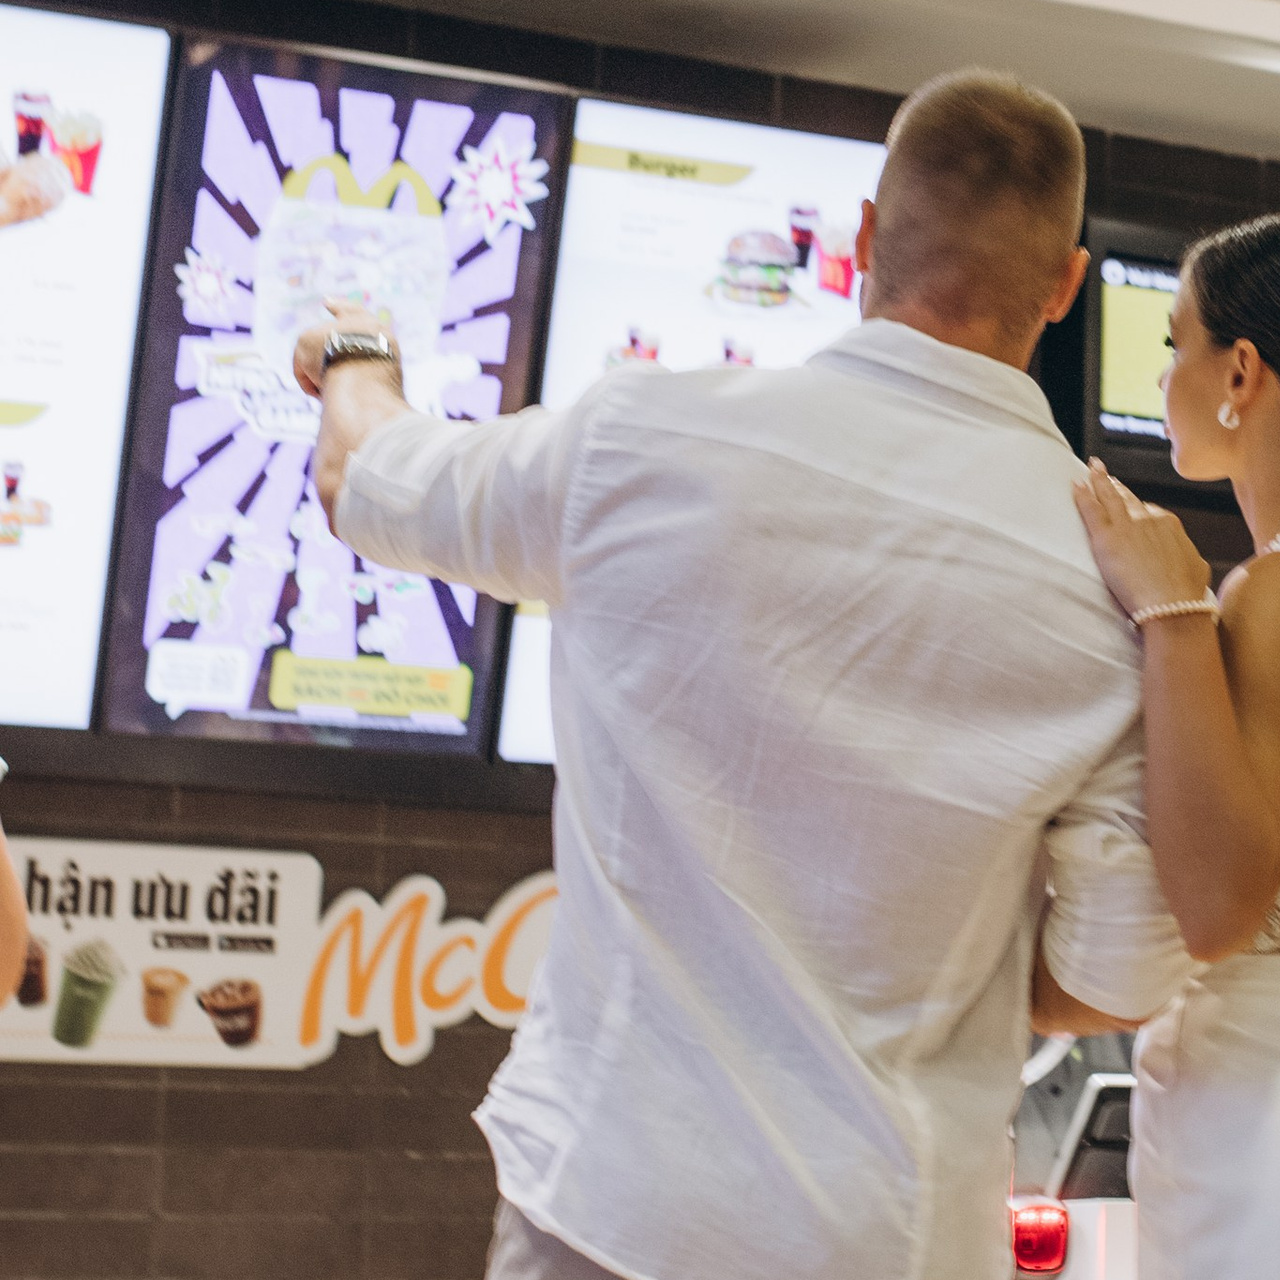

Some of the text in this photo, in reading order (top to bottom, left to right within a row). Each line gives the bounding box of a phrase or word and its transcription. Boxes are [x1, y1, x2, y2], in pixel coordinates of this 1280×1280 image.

[627, 151, 698, 179] Burger
[26, 858, 115, 931] hận
[206, 867, 280, 926] đãi
[298, 886, 559, 1048] McC
